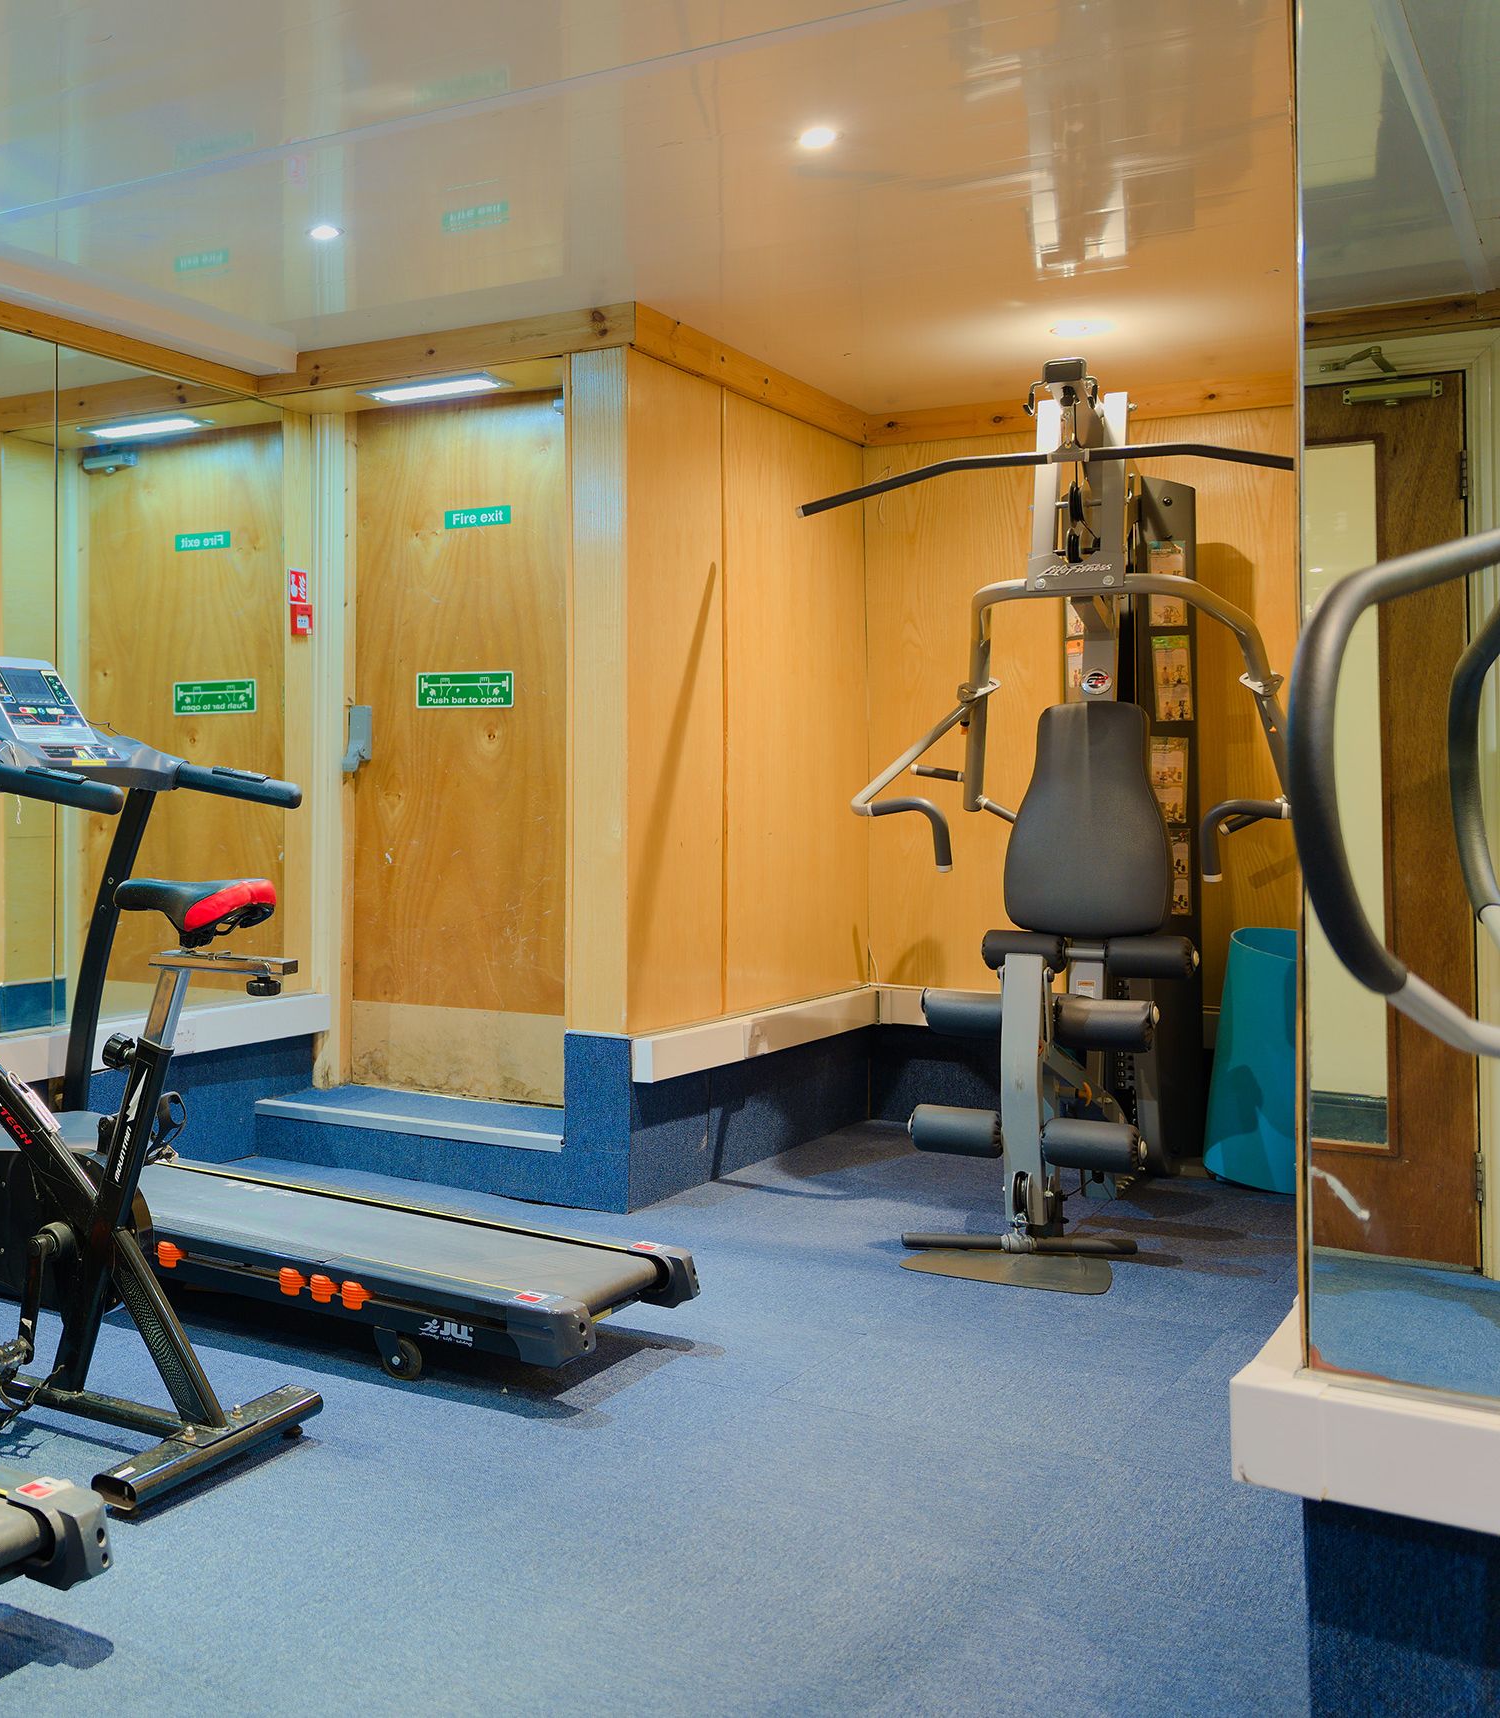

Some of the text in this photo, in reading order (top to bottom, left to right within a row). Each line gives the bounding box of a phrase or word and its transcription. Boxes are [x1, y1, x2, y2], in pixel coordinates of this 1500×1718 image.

[452, 510, 503, 525] Fire exit
[426, 696, 504, 705] Push bar to open
[440, 1321, 473, 1342] JLL
